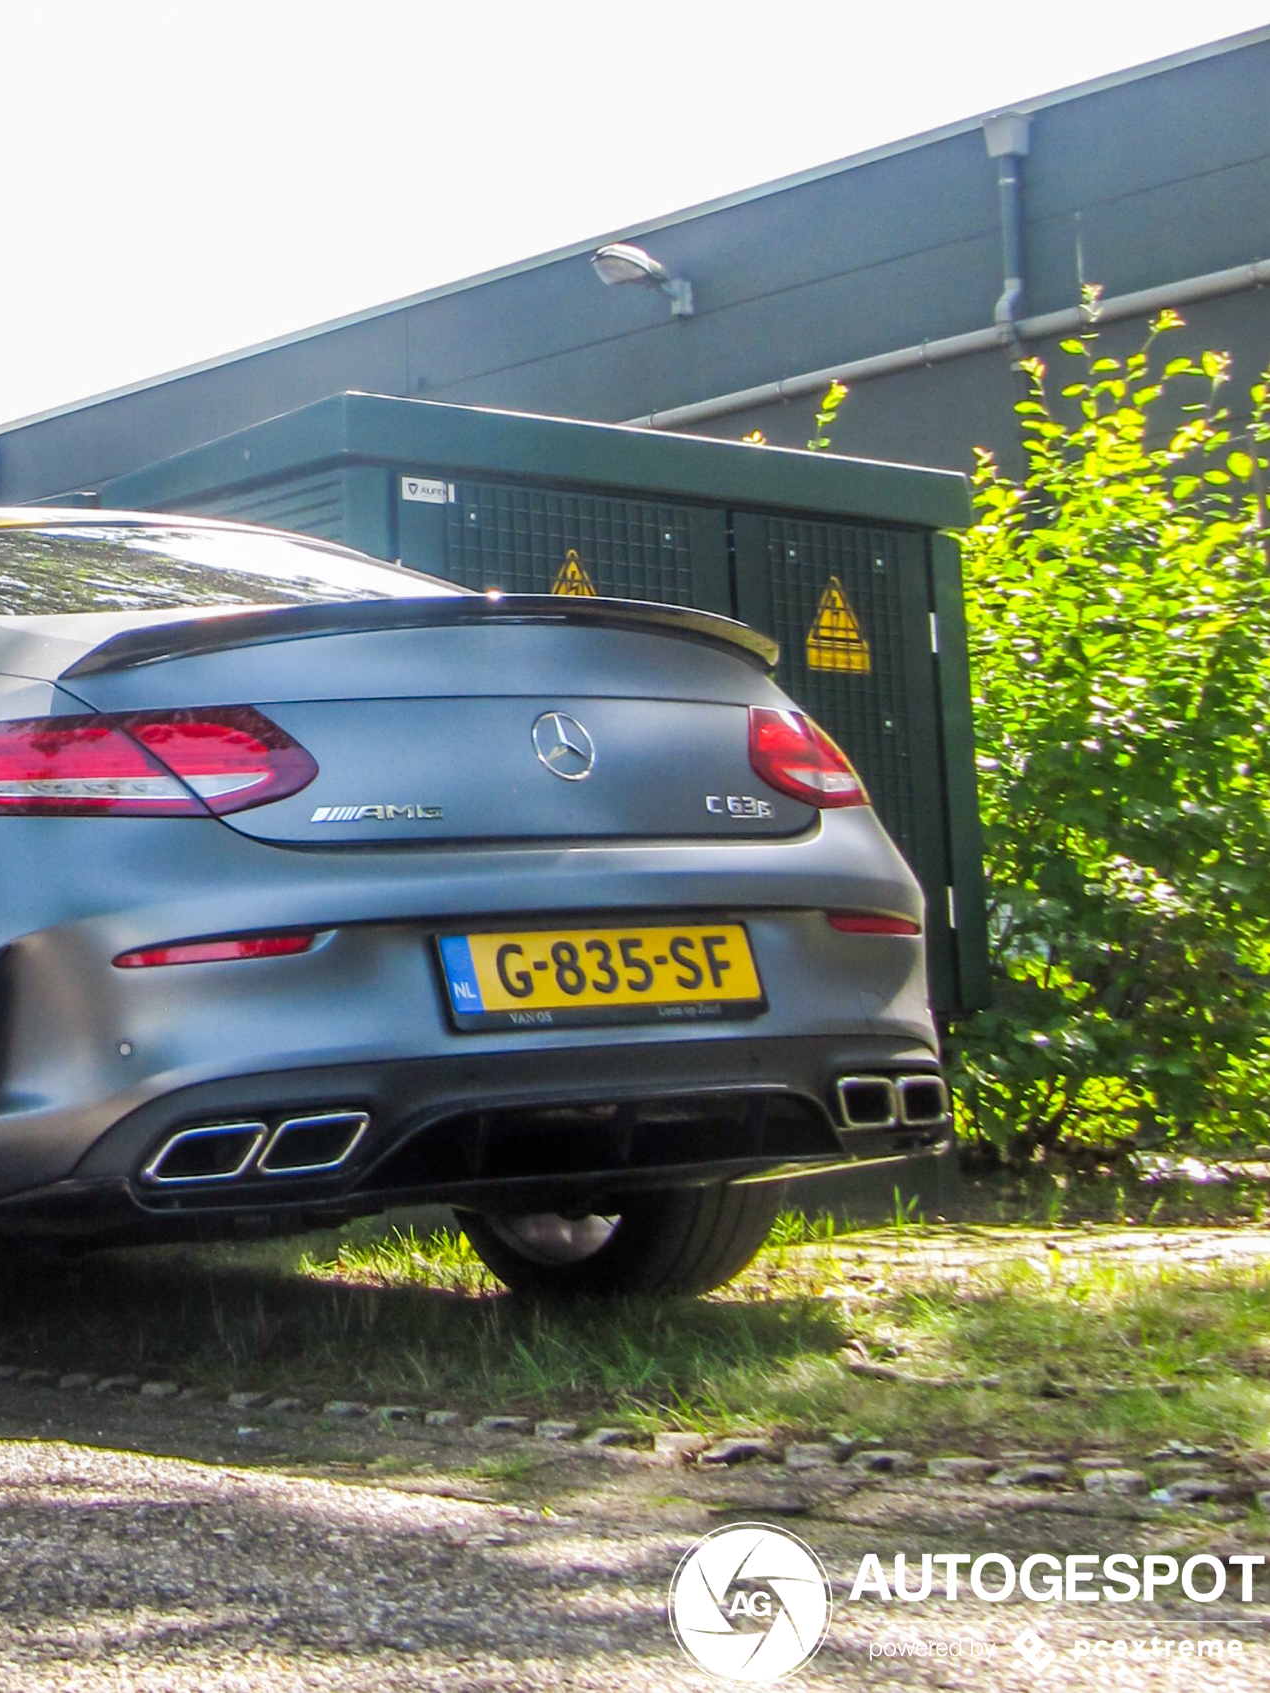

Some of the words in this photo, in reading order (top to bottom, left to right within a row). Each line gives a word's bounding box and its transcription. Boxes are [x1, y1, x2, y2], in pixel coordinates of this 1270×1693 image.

[705, 795, 723, 813] C
[496, 935, 731, 998] G-835-SF
[453, 982, 477, 999] NL
[509, 1011, 534, 1024] VAN
